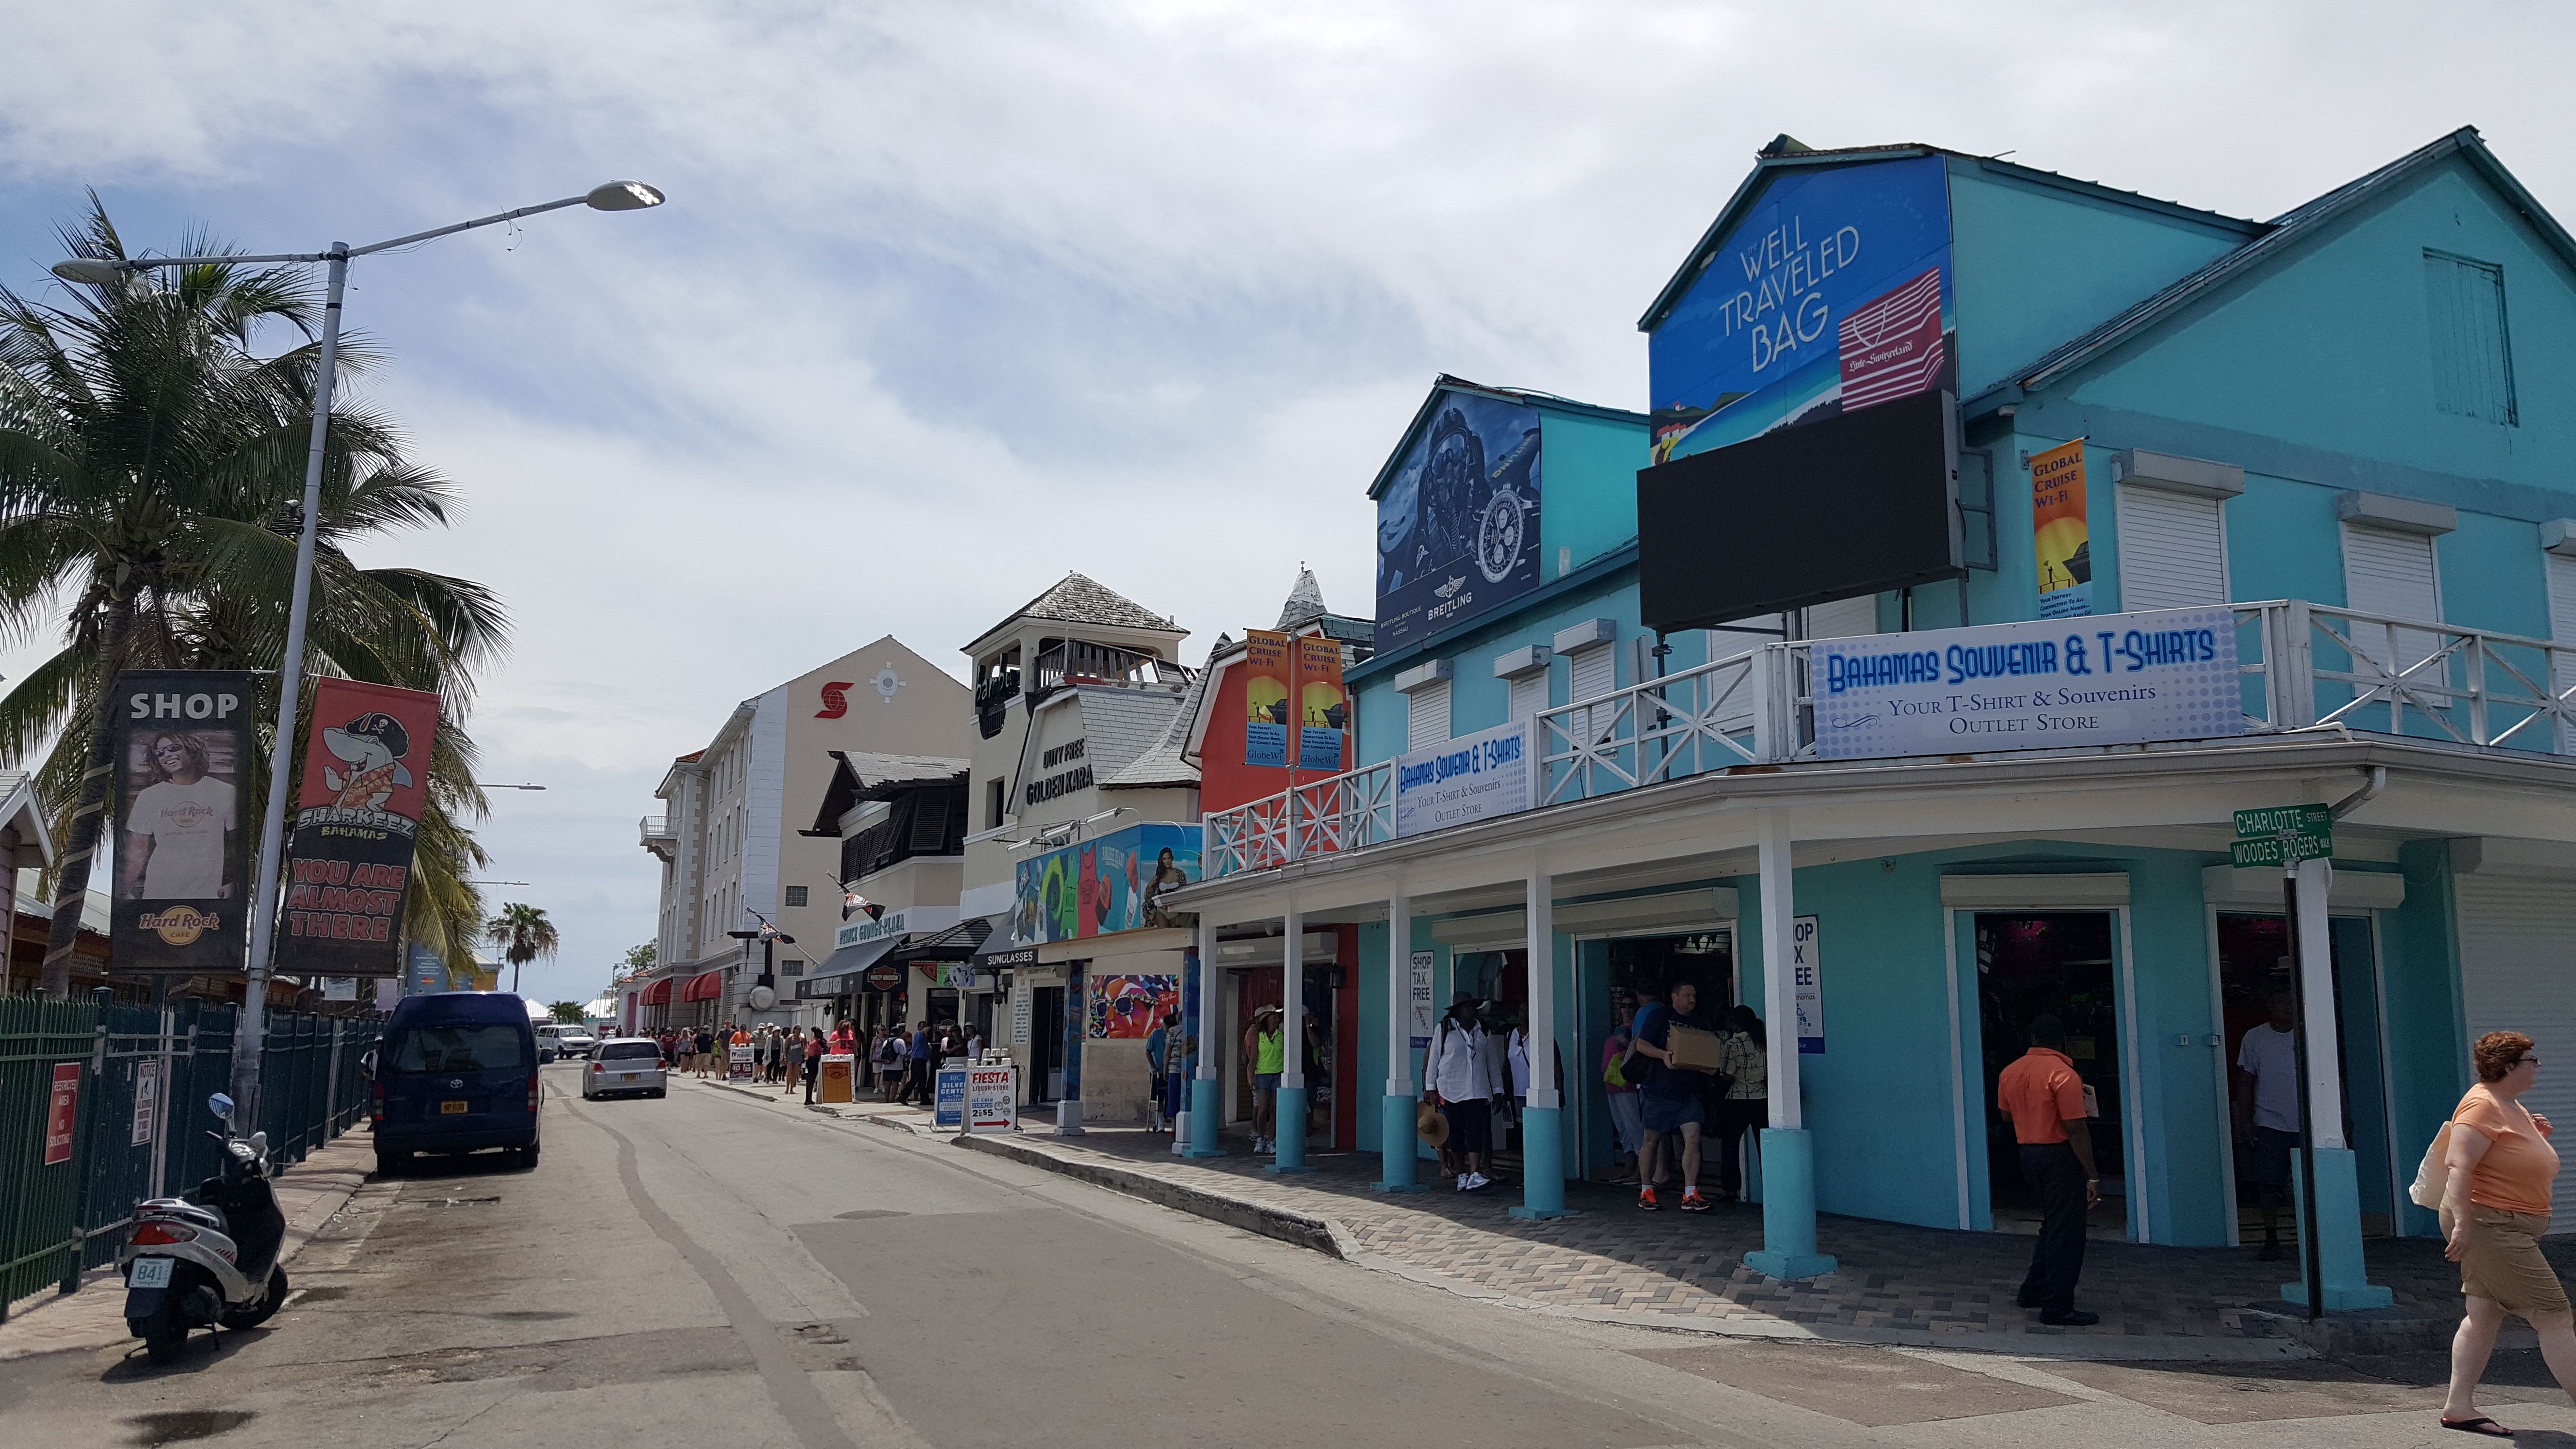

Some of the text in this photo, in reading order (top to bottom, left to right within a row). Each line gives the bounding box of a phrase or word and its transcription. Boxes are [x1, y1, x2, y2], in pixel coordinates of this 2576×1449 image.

[1740, 215, 1807, 282] WELL
[1719, 225, 1859, 337] TRAVELED
[1752, 292, 1828, 373] BAG
[1848, 340, 1913, 372] Little Switzerland
[2034, 453, 2082, 477] GLOBAL
[2034, 470, 2077, 492] CRUISE
[1381, 606, 1422, 628] BREITLING BOUTIQUE
[1428, 592, 1472, 621] BREITLING
[1249, 636, 1286, 647] GLOBAL
[1392, 626, 1408, 637] NASSAU
[1249, 647, 1282, 657] CRUISE
[1304, 644, 1340, 654] GLOBAL
[1304, 653, 1336, 664] CRUISE
[1828, 628, 2215, 694] BAHAMAS SOUVENIR & T-SHIRTS
[130, 693, 238, 719] SHOP
[1888, 685, 2156, 717] YOUR T-SHIRT & Souvenirs
[1948, 714, 2100, 735] OUTLET STORE
[1043, 738, 1084, 768] DUTY FREE
[1247, 750, 1282, 760] GlobeWi
[1301, 755, 1336, 764] GlobeWi
[1400, 736, 1520, 793] BAHAMAS SOUVENIR & T-SHIRTS
[1027, 773, 1065, 805] GOLDEN
[1417, 780, 1500, 808] YOUR T-SHIRT & Souvenirs
[297, 806, 417, 838] SHARKEEZ
[1435, 804, 1482, 822] OUTLET STORE
[2236, 809, 2327, 834] CHARLOTTE STREET
[321, 826, 387, 841] BAHAMAS
[2233, 835, 2330, 864] WOODES ROGERS WALK
[292, 858, 406, 889] YOU ARE
[287, 886, 400, 915] ALMOST
[139, 912, 220, 930] Hard Rock
[291, 913, 390, 941] THERE
[839, 914, 904, 945] PRINCE GEORGE PLAZA
[1795, 923, 1814, 942] OP
[988, 951, 1033, 965] SUNGLASSES
[1413, 956, 1432, 969] SHOP
[1413, 972, 1426, 985] TAX
[1796, 967, 1812, 985] EE
[1159, 992, 1176, 1002] Ray-Ban
[1413, 987, 1430, 1000] FREE
[140, 1064, 155, 1079] NOTICE
[972, 1072, 1009, 1083] FIESTA
[58, 1119, 65, 1130] NO
[49, 1133, 70, 1147] SOLICITING
